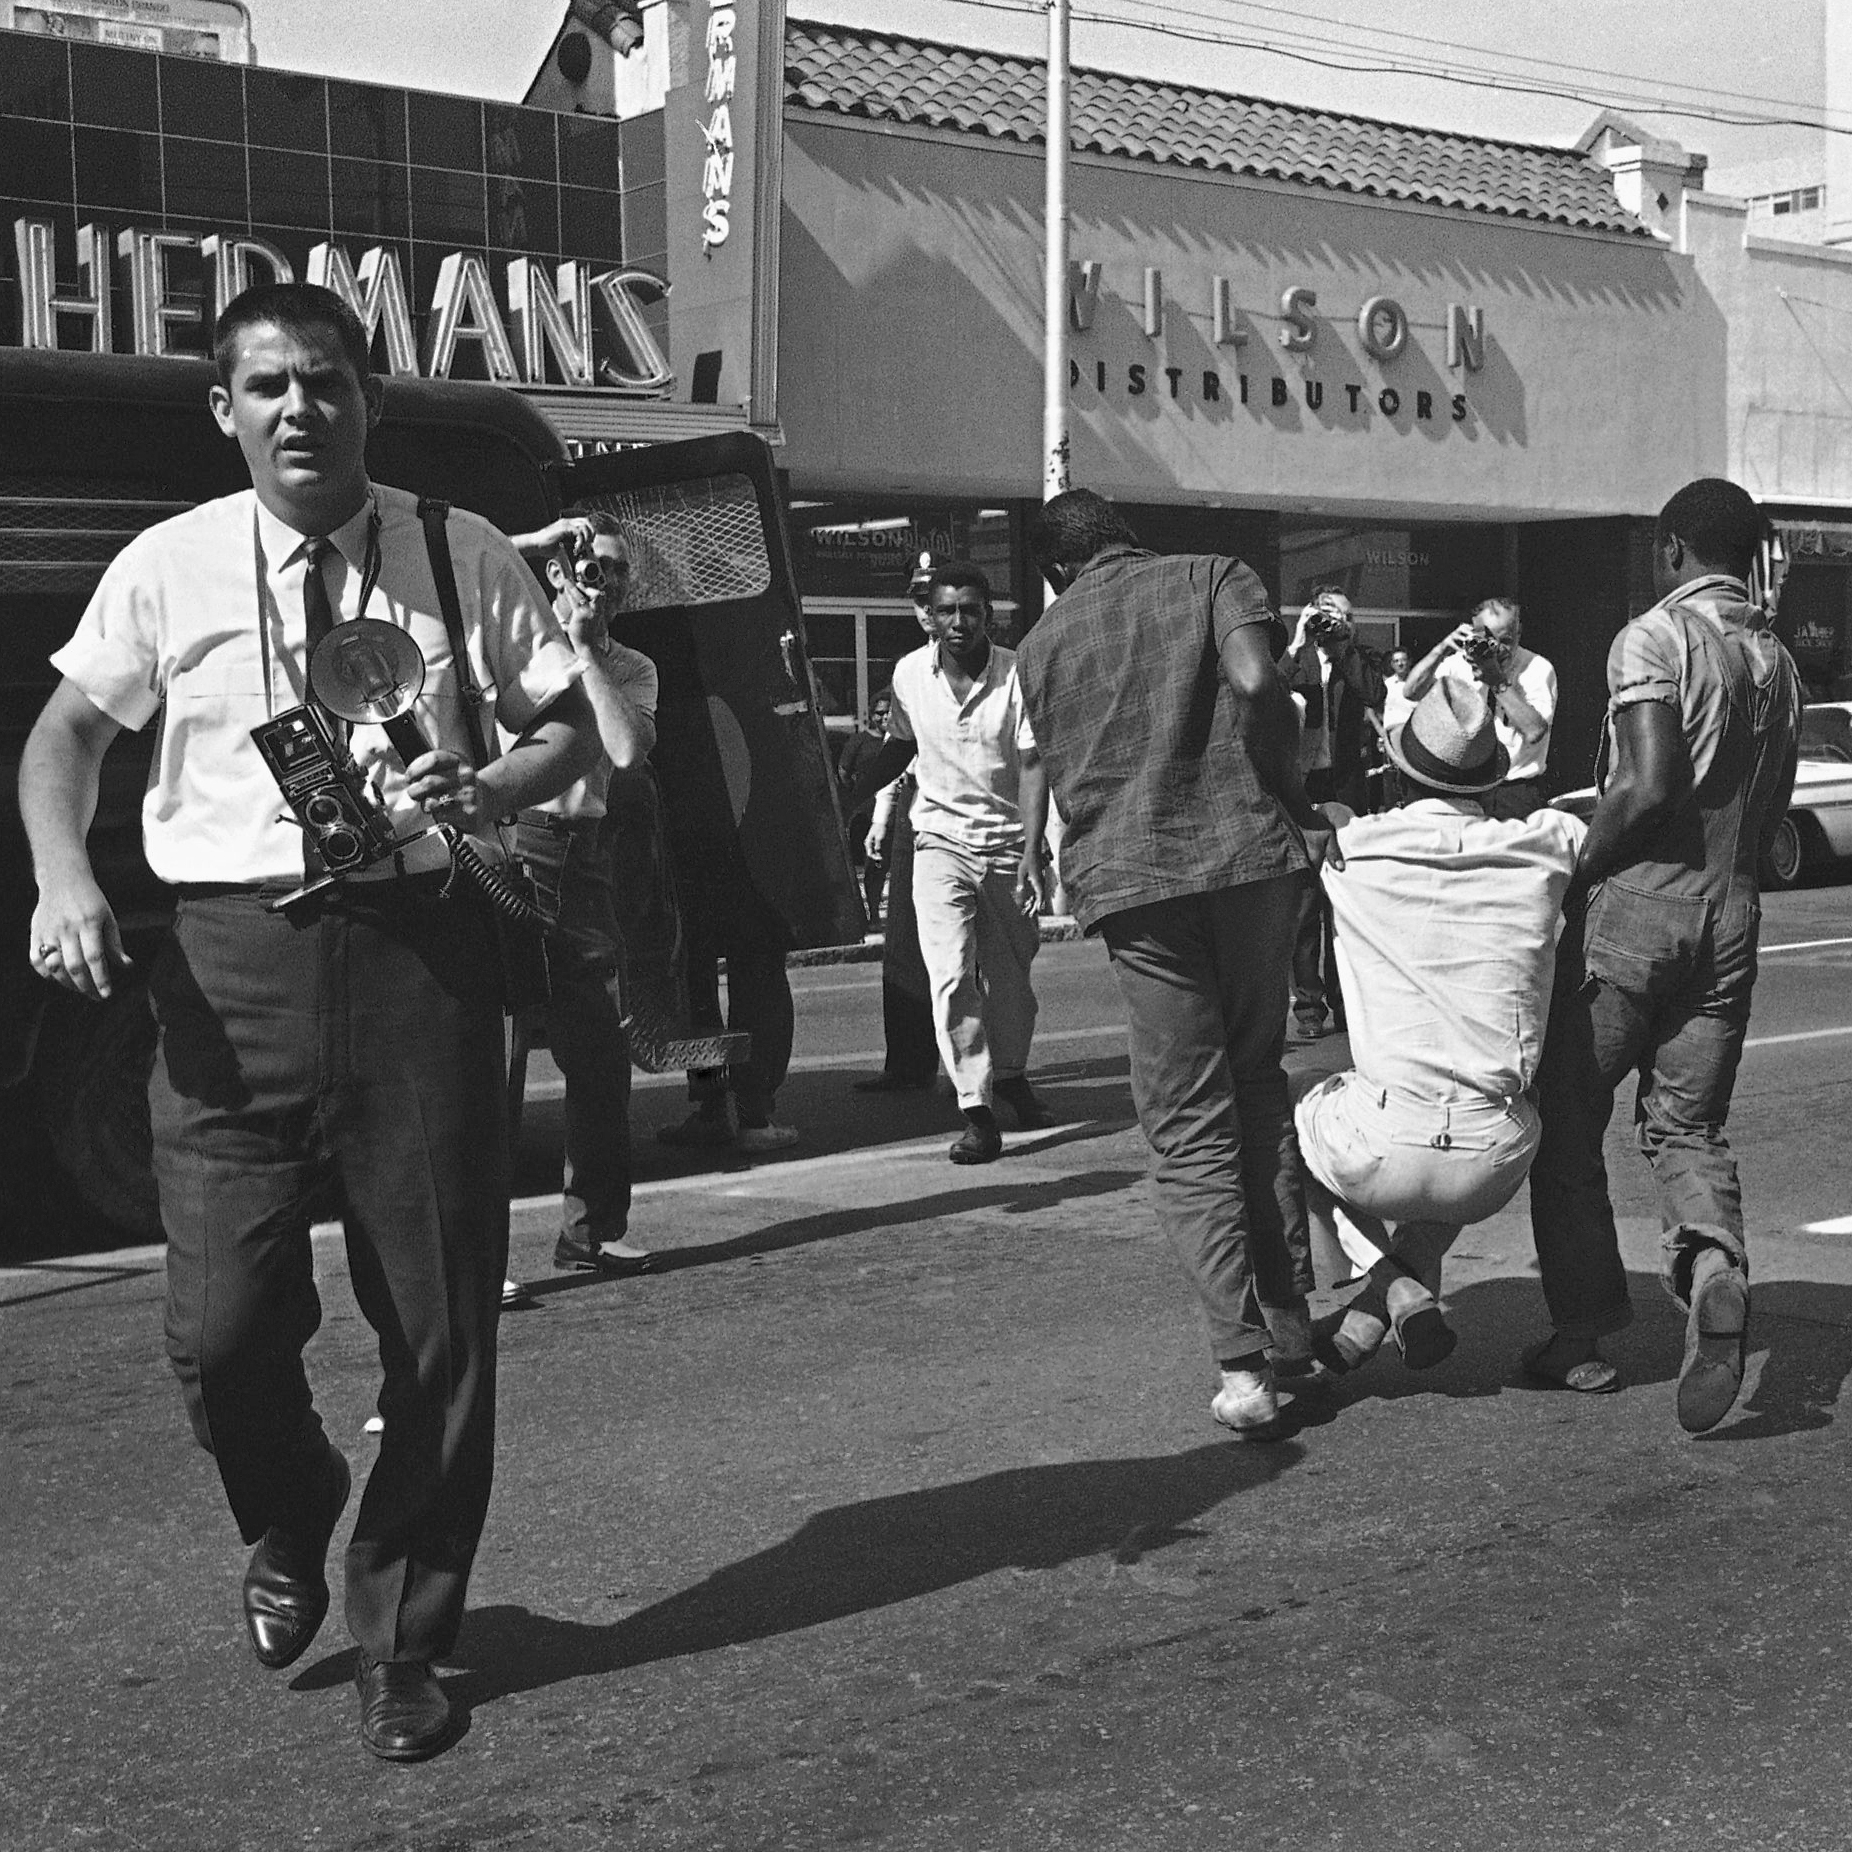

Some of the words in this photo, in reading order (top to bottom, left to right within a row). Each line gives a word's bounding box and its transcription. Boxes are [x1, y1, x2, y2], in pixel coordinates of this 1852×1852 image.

[702, 0, 736, 248] RMANS
[815, 529, 903, 547] WILSON
[1366, 549, 1430, 566] WILSON
